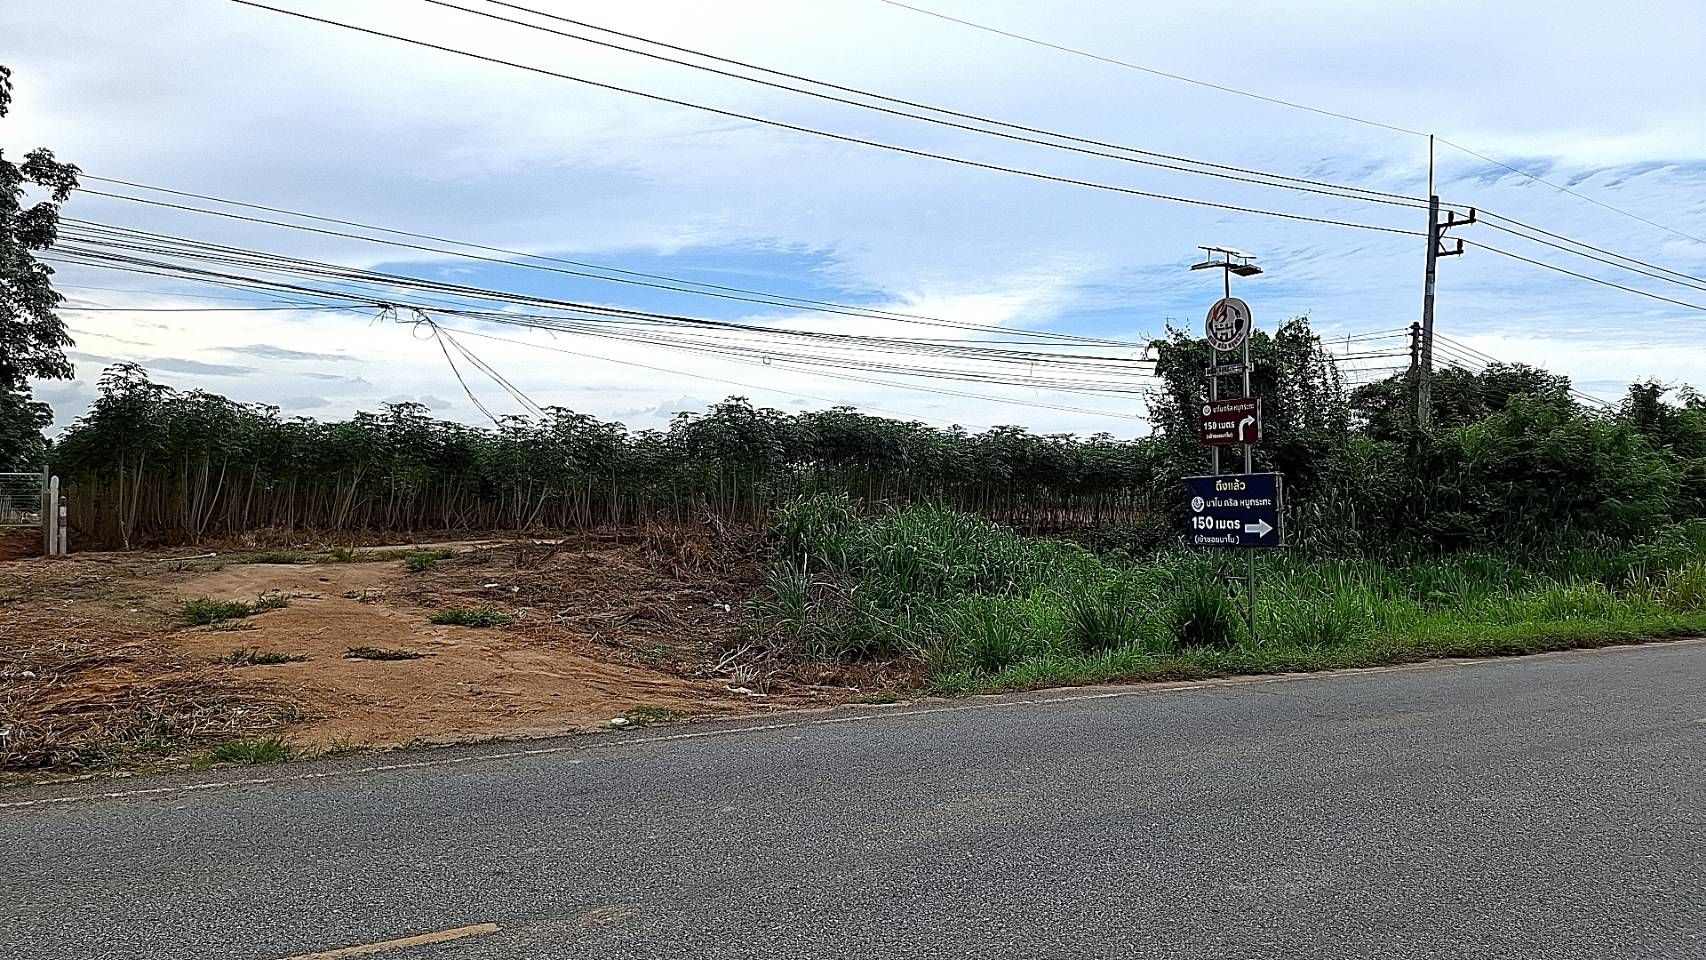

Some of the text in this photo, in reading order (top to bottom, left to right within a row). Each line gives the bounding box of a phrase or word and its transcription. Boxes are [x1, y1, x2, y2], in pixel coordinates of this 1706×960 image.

[1203, 421, 1217, 430] 150
[1215, 478, 1246, 491] ถึงแล้ว
[1191, 515, 1241, 530] 150 เมตร
